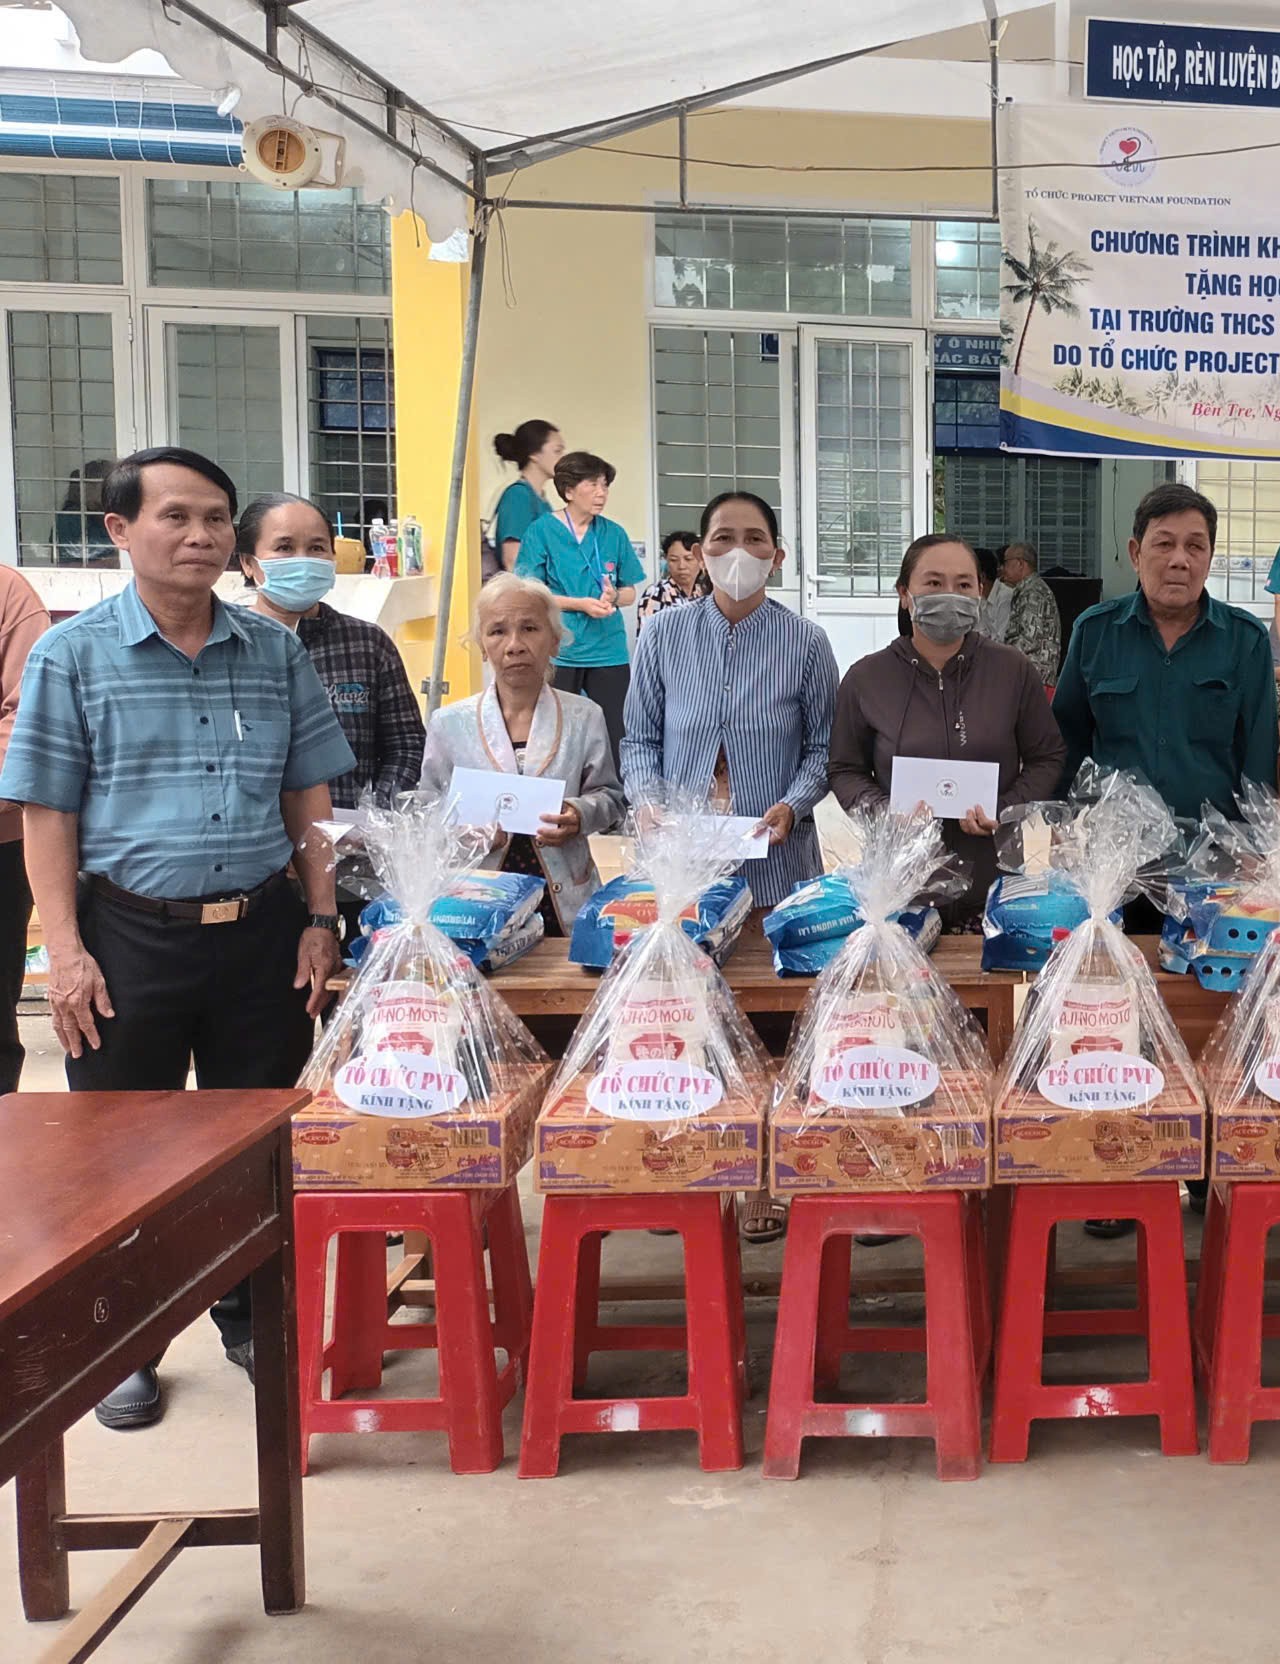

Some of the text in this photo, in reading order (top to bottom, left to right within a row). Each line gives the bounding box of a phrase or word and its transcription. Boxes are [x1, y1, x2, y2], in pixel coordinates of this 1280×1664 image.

[1113, 45, 1143, 88] HỌC
[1148, 41, 1179, 91] TẬP,
[1185, 42, 1215, 85] RÈN
[1220, 45, 1267, 95] LUYỆN
[1025, 187, 1231, 206] TỔ CHỨC PROJECT VIETNAM FOUNDATION
[1091, 229, 1179, 256] CHƯƠNG
[1187, 231, 1249, 257] TRÌNH
[1186, 269, 1241, 300] TẶNG
[1090, 308, 1120, 335] TẠI
[1129, 306, 1213, 334] TRƯỜNG
[1221, 313, 1274, 335] THCS
[1054, 345, 1081, 365] DO
[1089, 339, 1115, 368] TỔ
[1122, 344, 1177, 371] CHỨC
[1185, 350, 1280, 375] PROJECT
[1228, 404, 1256, 419] Tre,
[343, 1057, 367, 1085] TỔ
[421, 1072, 459, 1092] PVF
[600, 1068, 715, 1095] TỔ CHỨC PVF
[823, 1055, 931, 1082] TỔ CHỨC PVF
[1046, 1060, 1154, 1086] TỔ CHỨC PVF
[360, 1094, 432, 1111] KÍNH TẶNG
[656, 1099, 690, 1111] TẶNG
[880, 1087, 911, 1099] TẶNG
[1069, 1090, 1136, 1104] KÍNH TẶNG
